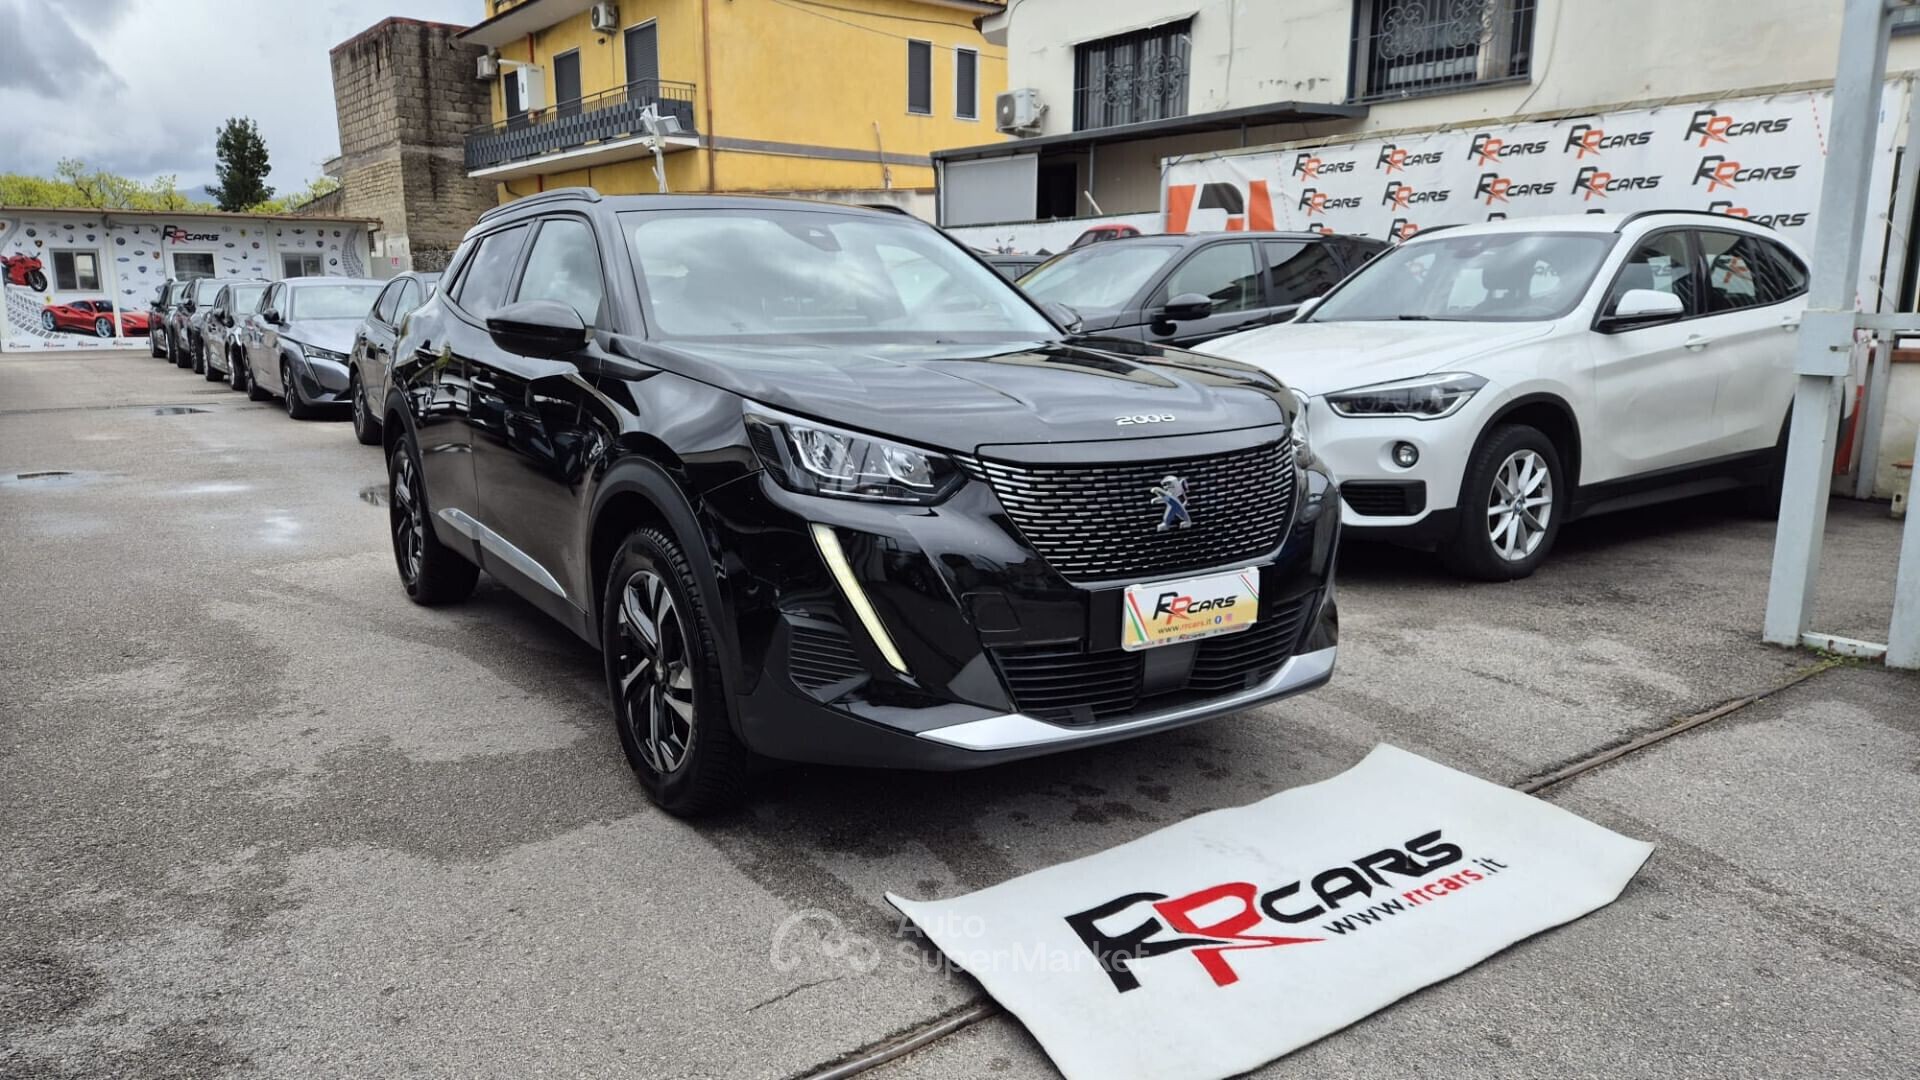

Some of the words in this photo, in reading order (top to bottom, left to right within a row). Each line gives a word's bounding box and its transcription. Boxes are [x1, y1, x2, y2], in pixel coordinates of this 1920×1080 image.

[1564, 124, 1654, 159] RRCARS
[1684, 109, 1792, 148] RRCARS
[1375, 143, 1444, 175] RRCARS
[1468, 133, 1549, 166] RRCARS
[1292, 153, 1356, 182] RRCARS
[1571, 166, 1664, 200] RRCARS
[1692, 155, 1801, 193] RRCARS
[1299, 188, 1363, 216] RRCARS
[1382, 181, 1452, 211] RRCARS
[1474, 172, 1558, 206] RRCARS
[1153, 592, 1238, 625] RRCARS
[1064, 829, 1463, 993] RRCARS
[1322, 857, 1508, 936] www.rrcars.it
